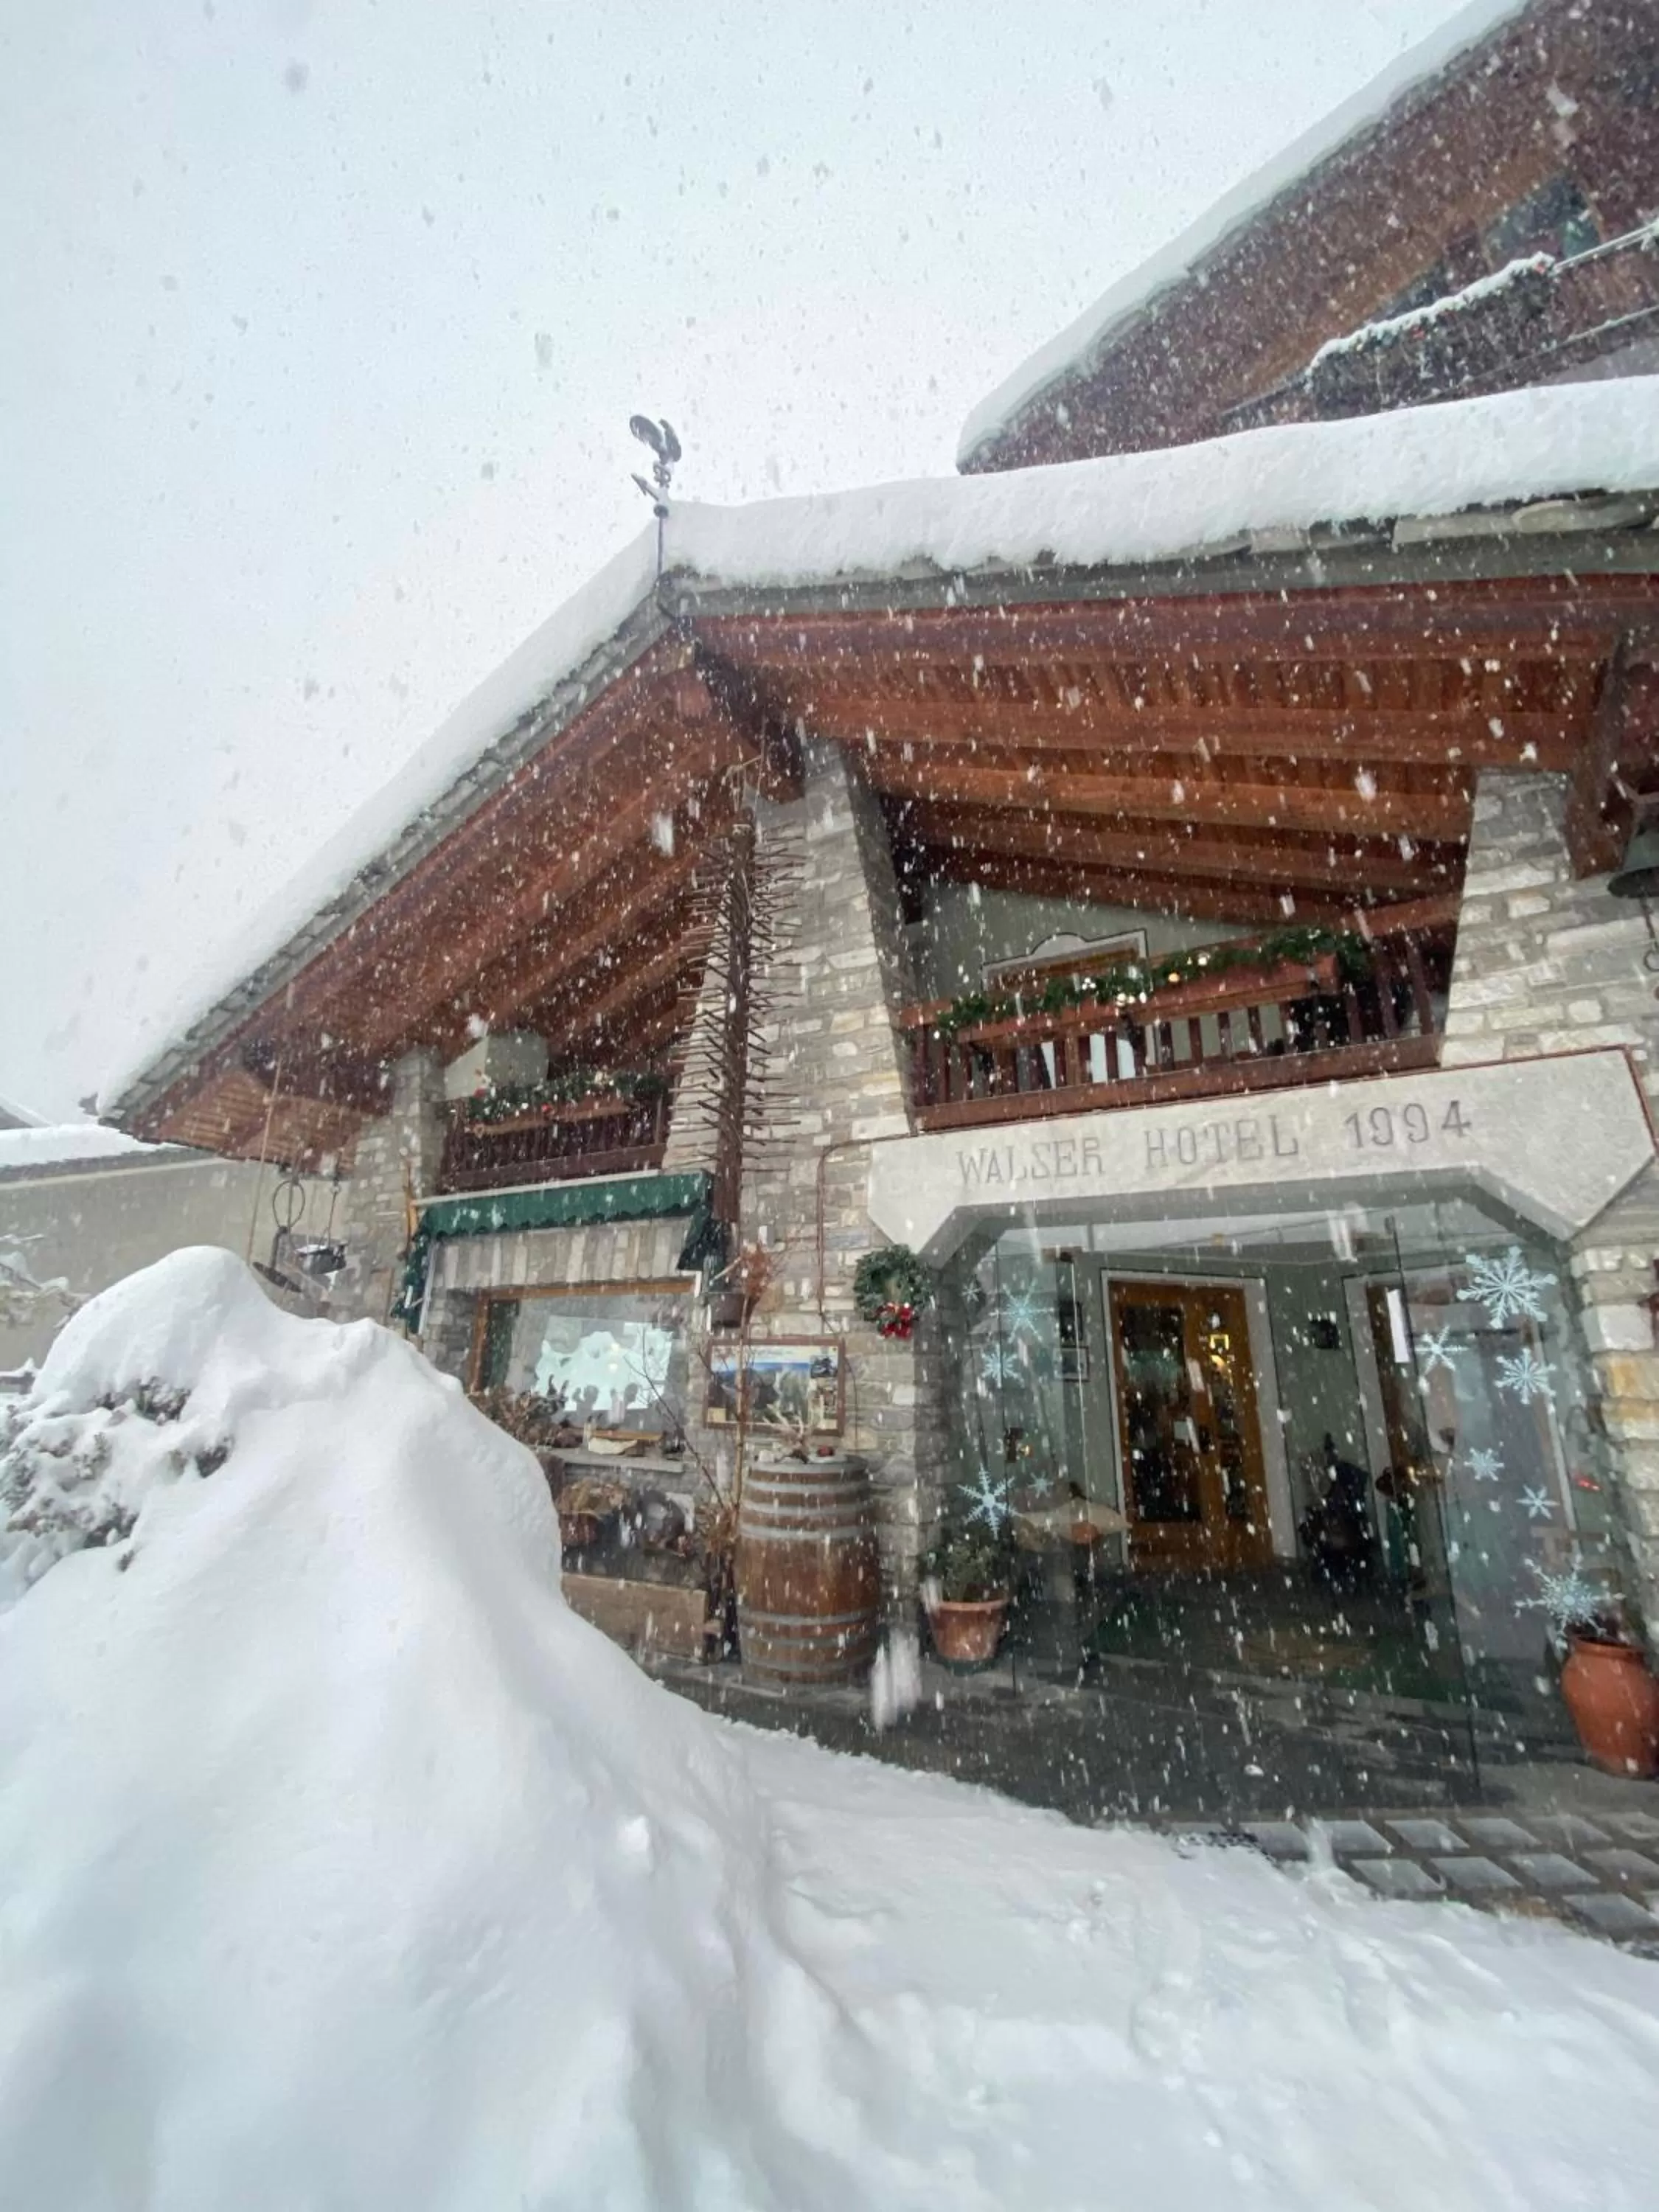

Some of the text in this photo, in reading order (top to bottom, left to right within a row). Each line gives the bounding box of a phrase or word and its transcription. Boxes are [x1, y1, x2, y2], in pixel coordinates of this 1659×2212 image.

[956, 1099, 1472, 1184] WALSER HOTEL 1994
